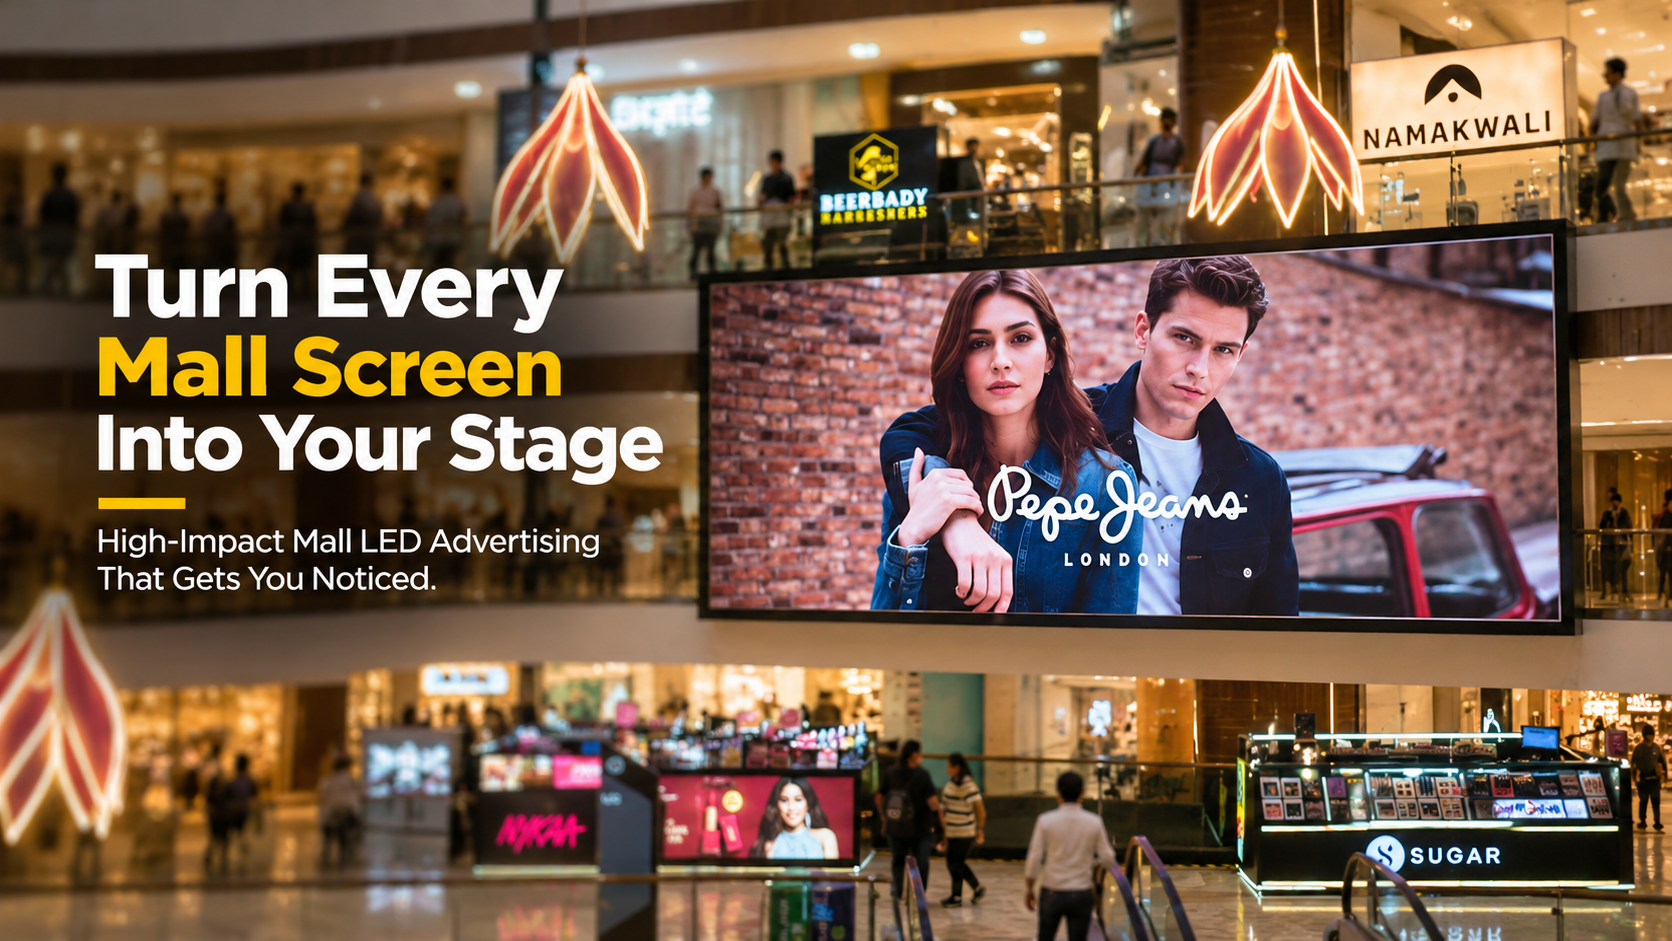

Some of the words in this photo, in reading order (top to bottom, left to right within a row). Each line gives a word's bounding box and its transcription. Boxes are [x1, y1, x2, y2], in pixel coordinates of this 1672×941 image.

[1363, 110, 1551, 151] NAMAKWALI
[819, 187, 929, 213] BEERBADY
[987, 464, 1100, 542] Pepe
[1099, 469, 1248, 544] Jeans
[1063, 552, 1169, 567] LONDON
[495, 813, 588, 855] NYKAA
[1410, 846, 1501, 865] SUGAR
